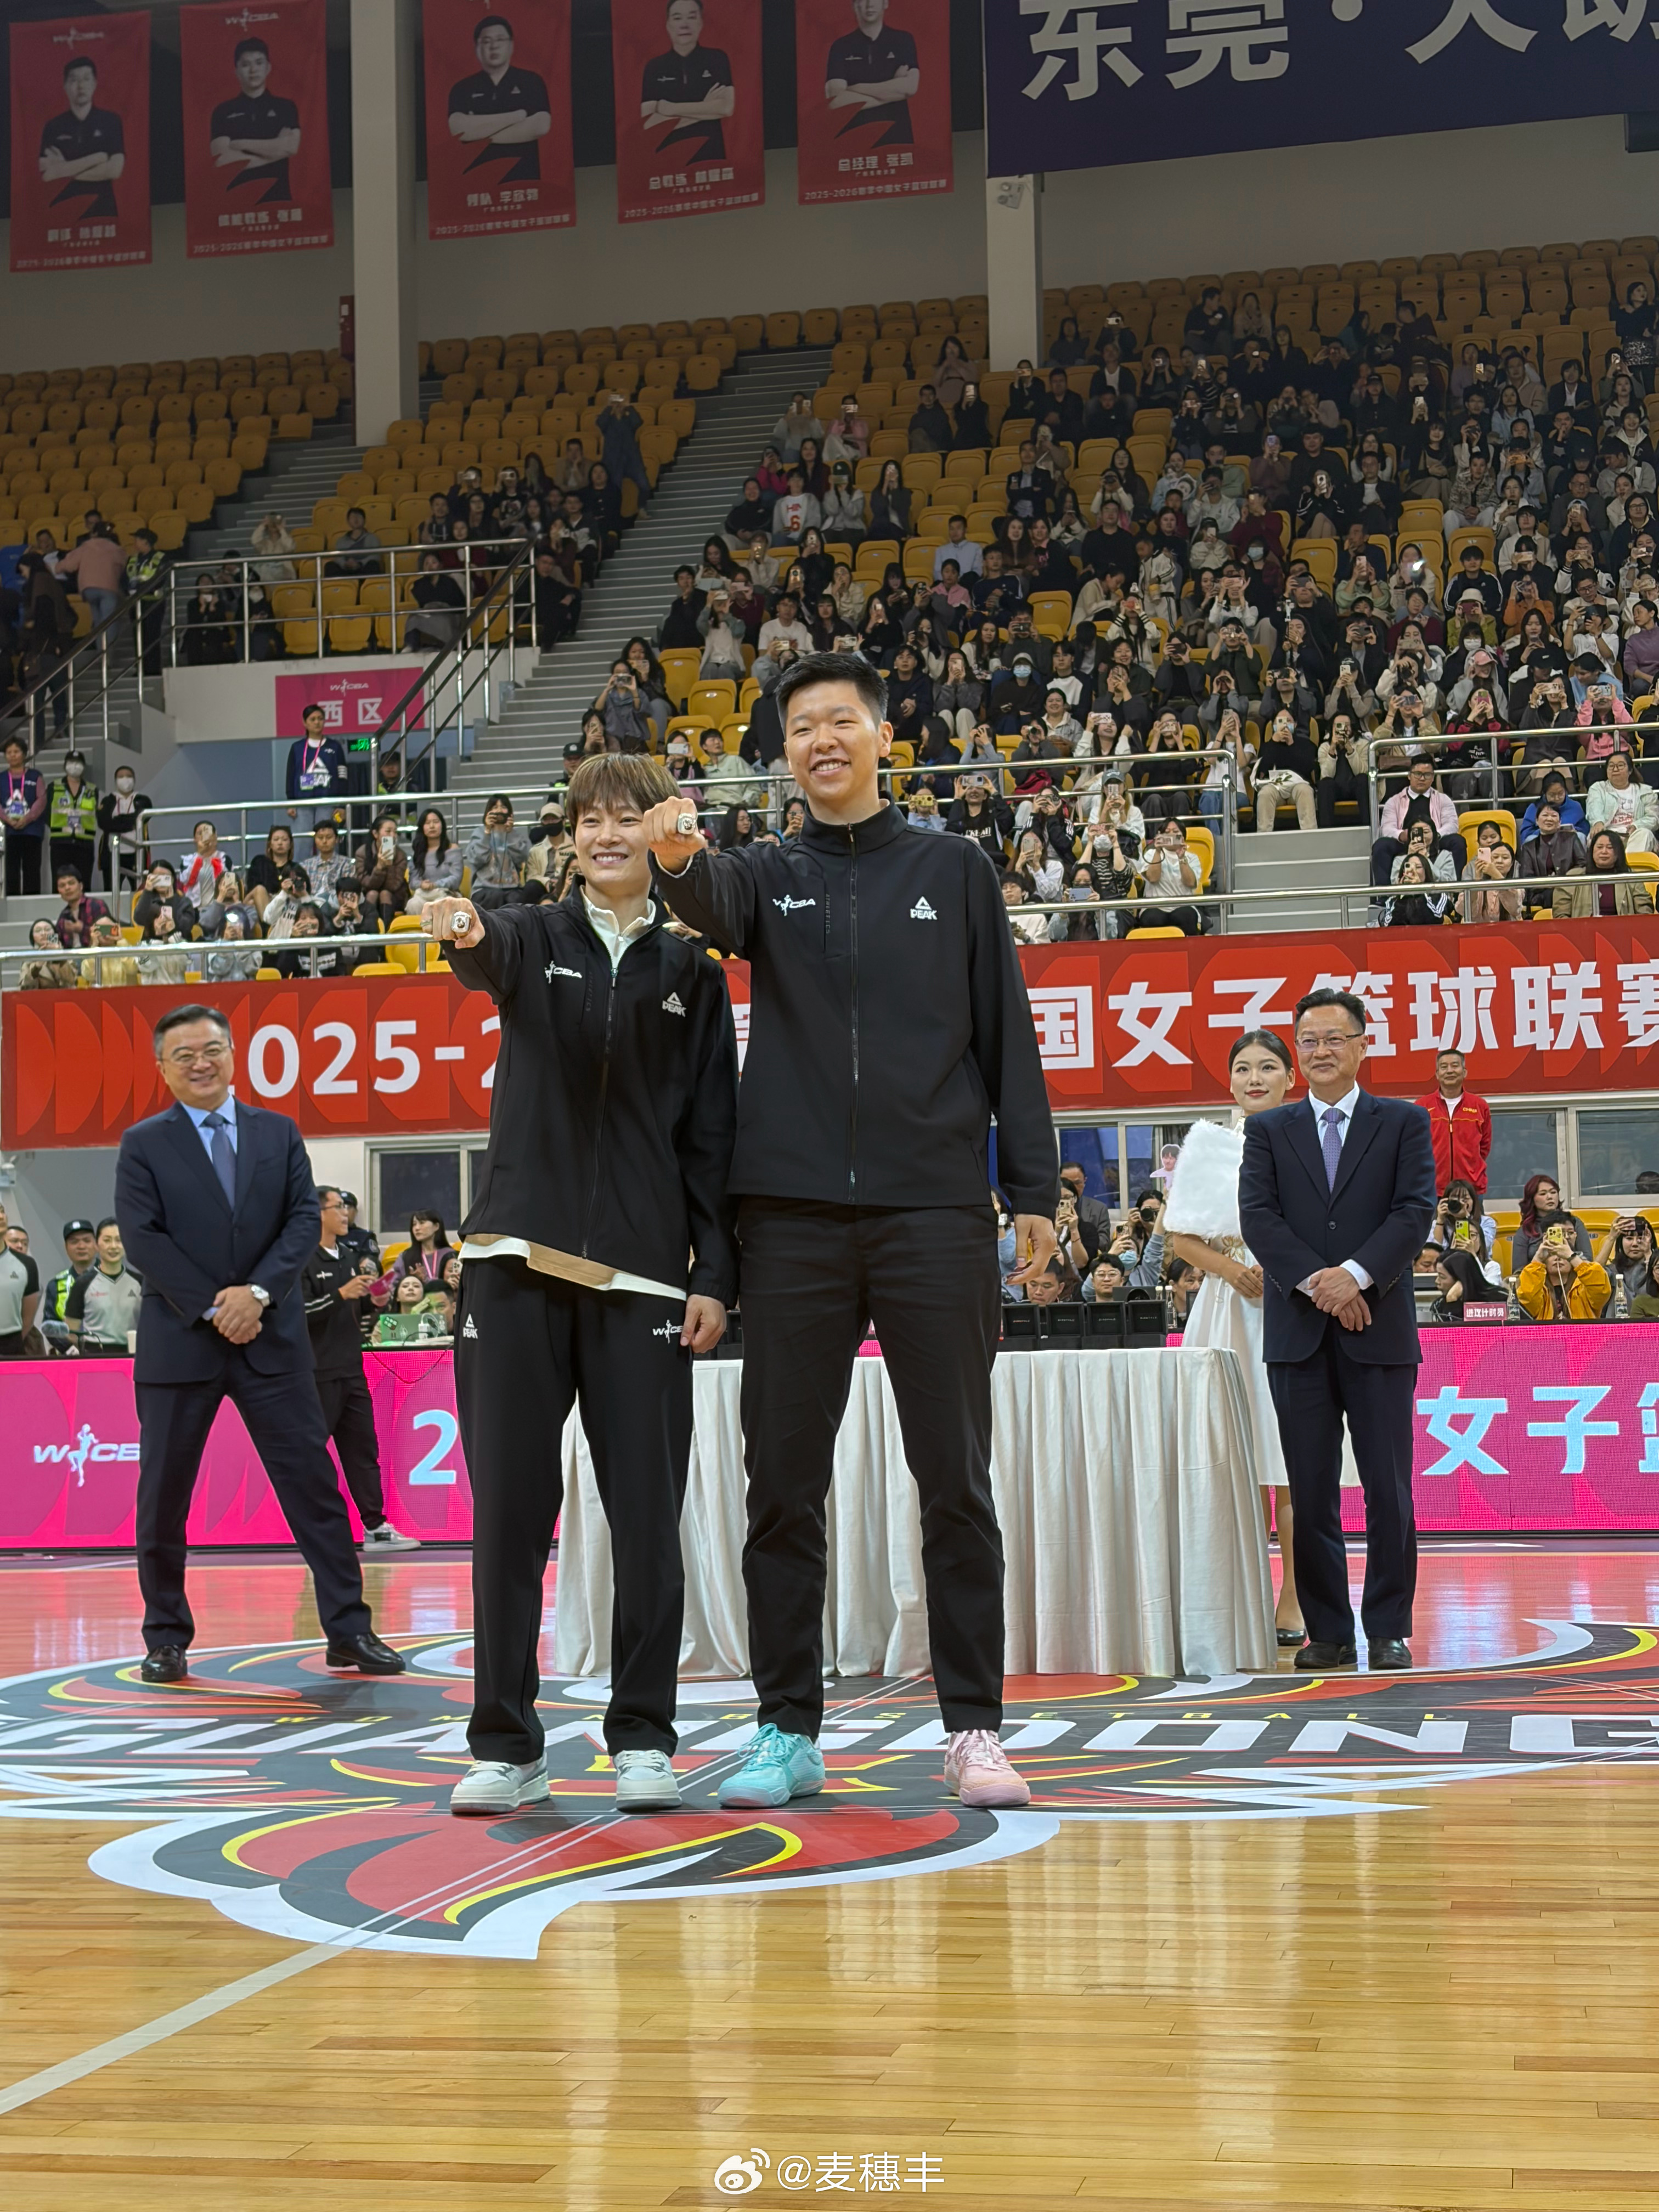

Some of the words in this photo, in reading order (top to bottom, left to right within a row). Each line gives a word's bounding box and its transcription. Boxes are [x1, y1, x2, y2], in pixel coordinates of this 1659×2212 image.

[838, 155, 879, 171] 总经理
[317, 697, 383, 727] 西区
[910, 909, 938, 920] PEAK
[662, 1000, 686, 1017] PEAK
[1466, 1307, 1504, 1318] 进攻计时员
[462, 1327, 478, 1339] PEAK
[1416, 1383, 1659, 1476] 女子
[408, 1409, 458, 1485] 2
